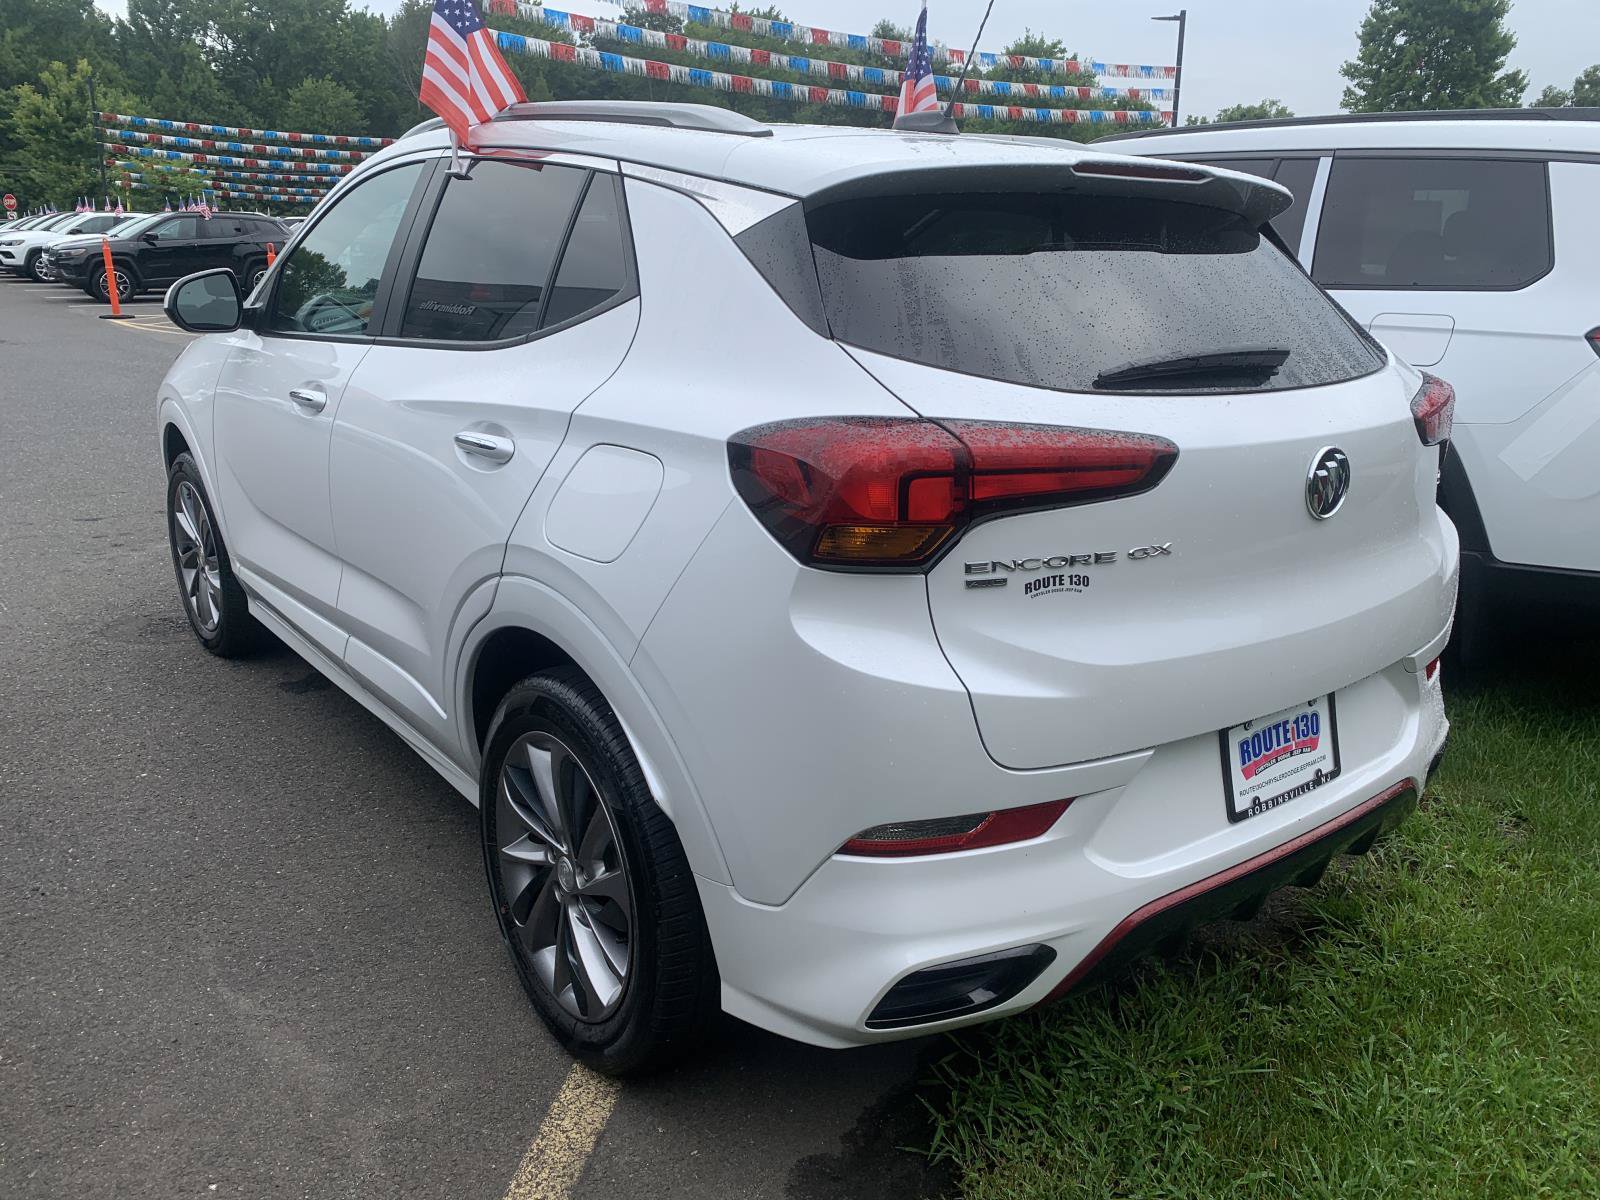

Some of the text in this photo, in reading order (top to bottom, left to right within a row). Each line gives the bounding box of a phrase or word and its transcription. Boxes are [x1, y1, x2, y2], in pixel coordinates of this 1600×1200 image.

[964, 542, 1172, 574] ENCORE GX
[1024, 574, 1090, 595] ROUTE 130
[1239, 712, 1320, 766] ROUTE 130
[1321, 774, 1331, 785] NJ
